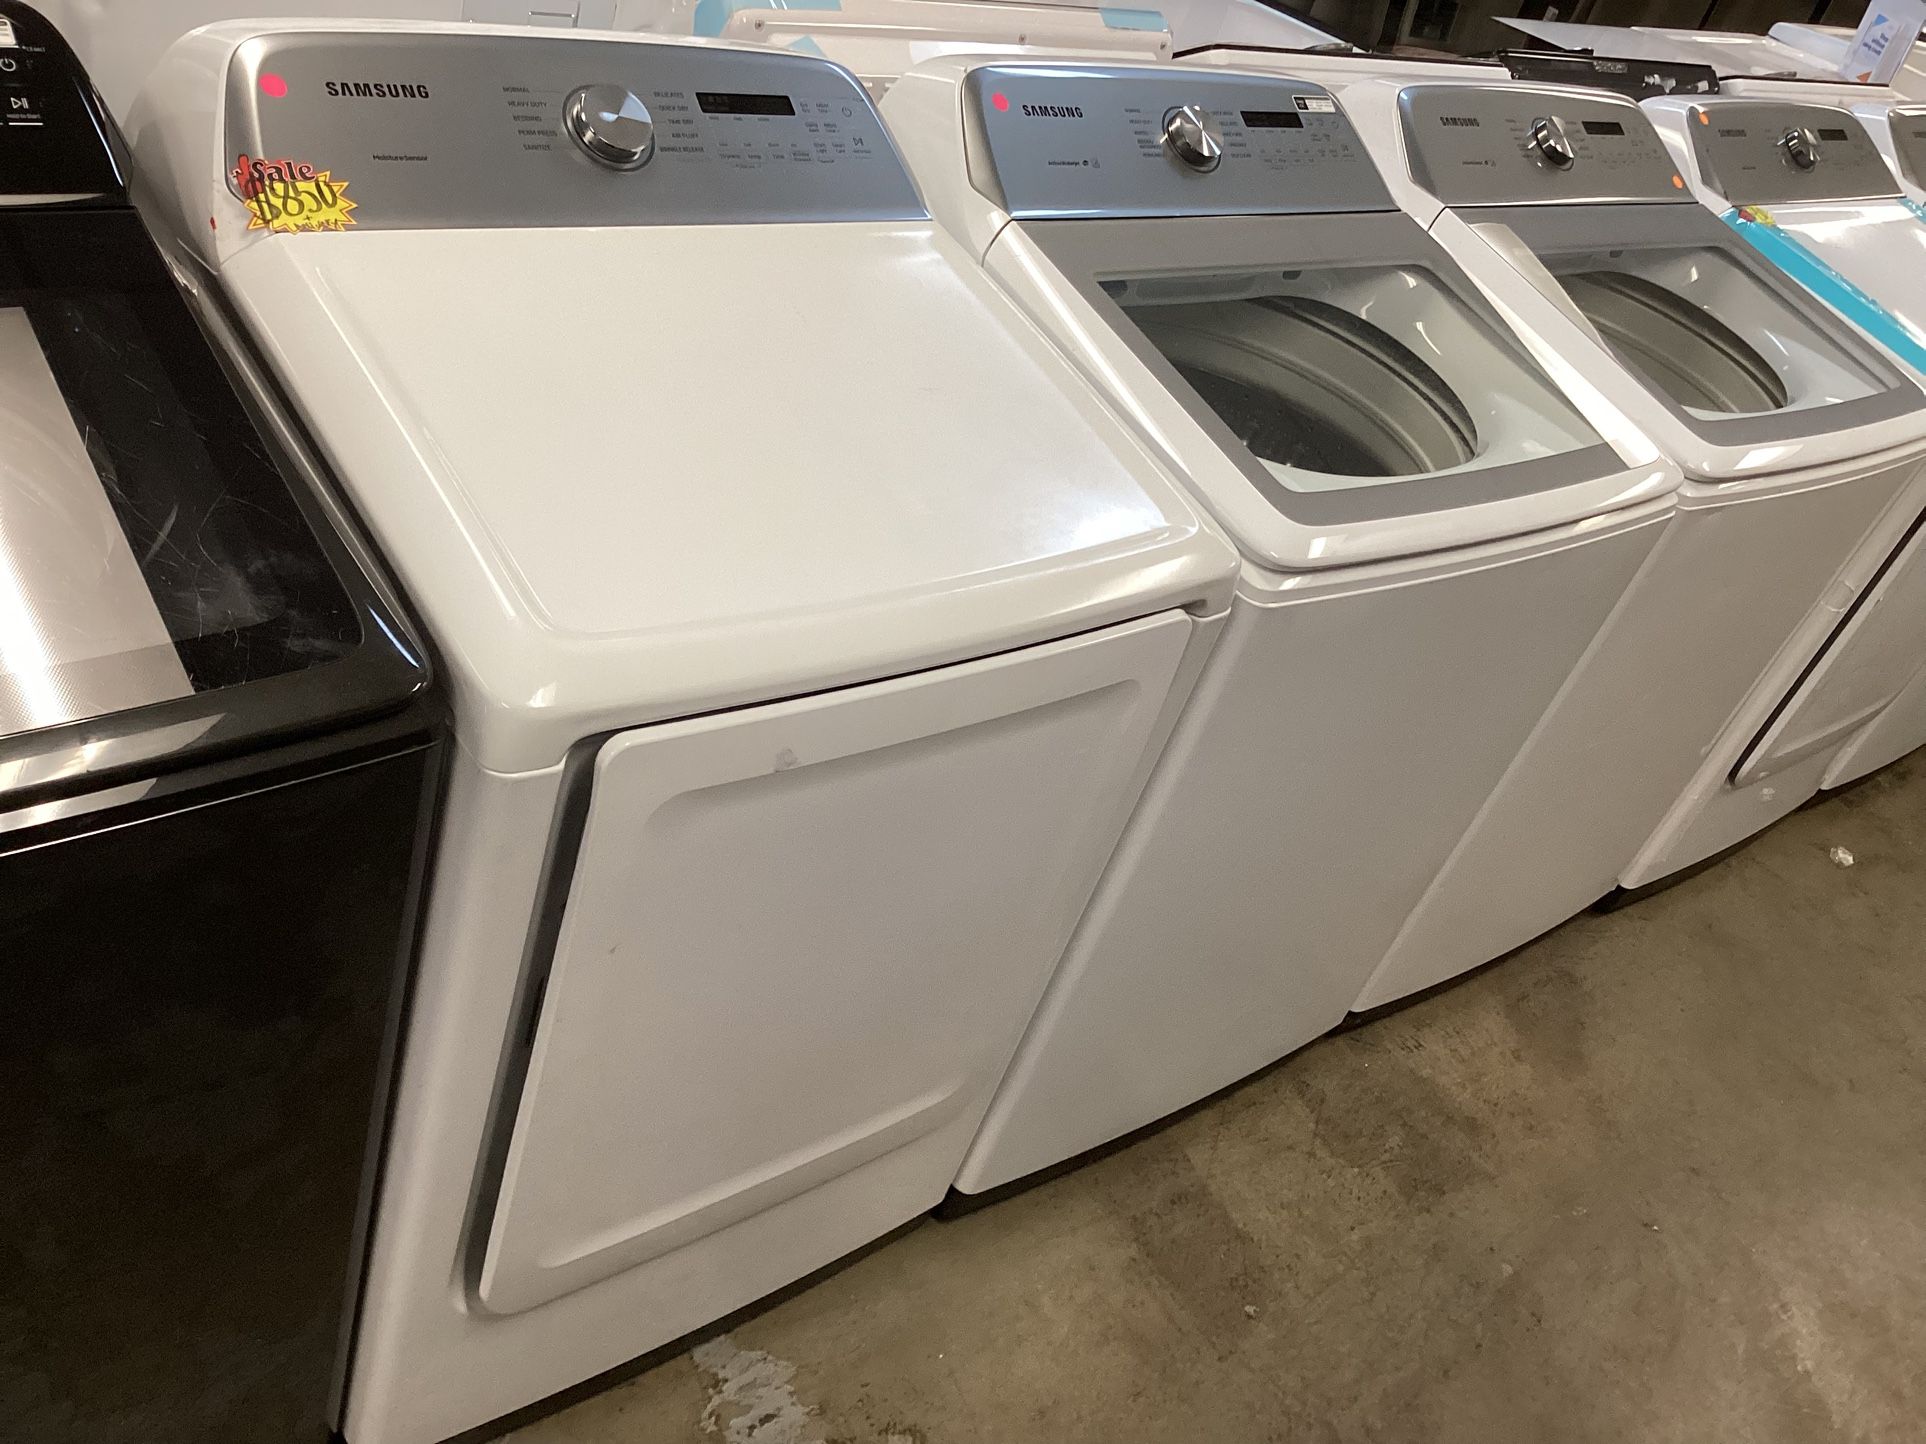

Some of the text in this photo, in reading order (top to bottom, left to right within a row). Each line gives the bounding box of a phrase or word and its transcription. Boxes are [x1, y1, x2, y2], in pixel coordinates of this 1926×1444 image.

[325, 81, 430, 99] SAMSUNG
[1022, 105, 1084, 118] SAMSUNG
[1440, 116, 1480, 127] SAMSUNG
[250, 160, 317, 182] Sale
